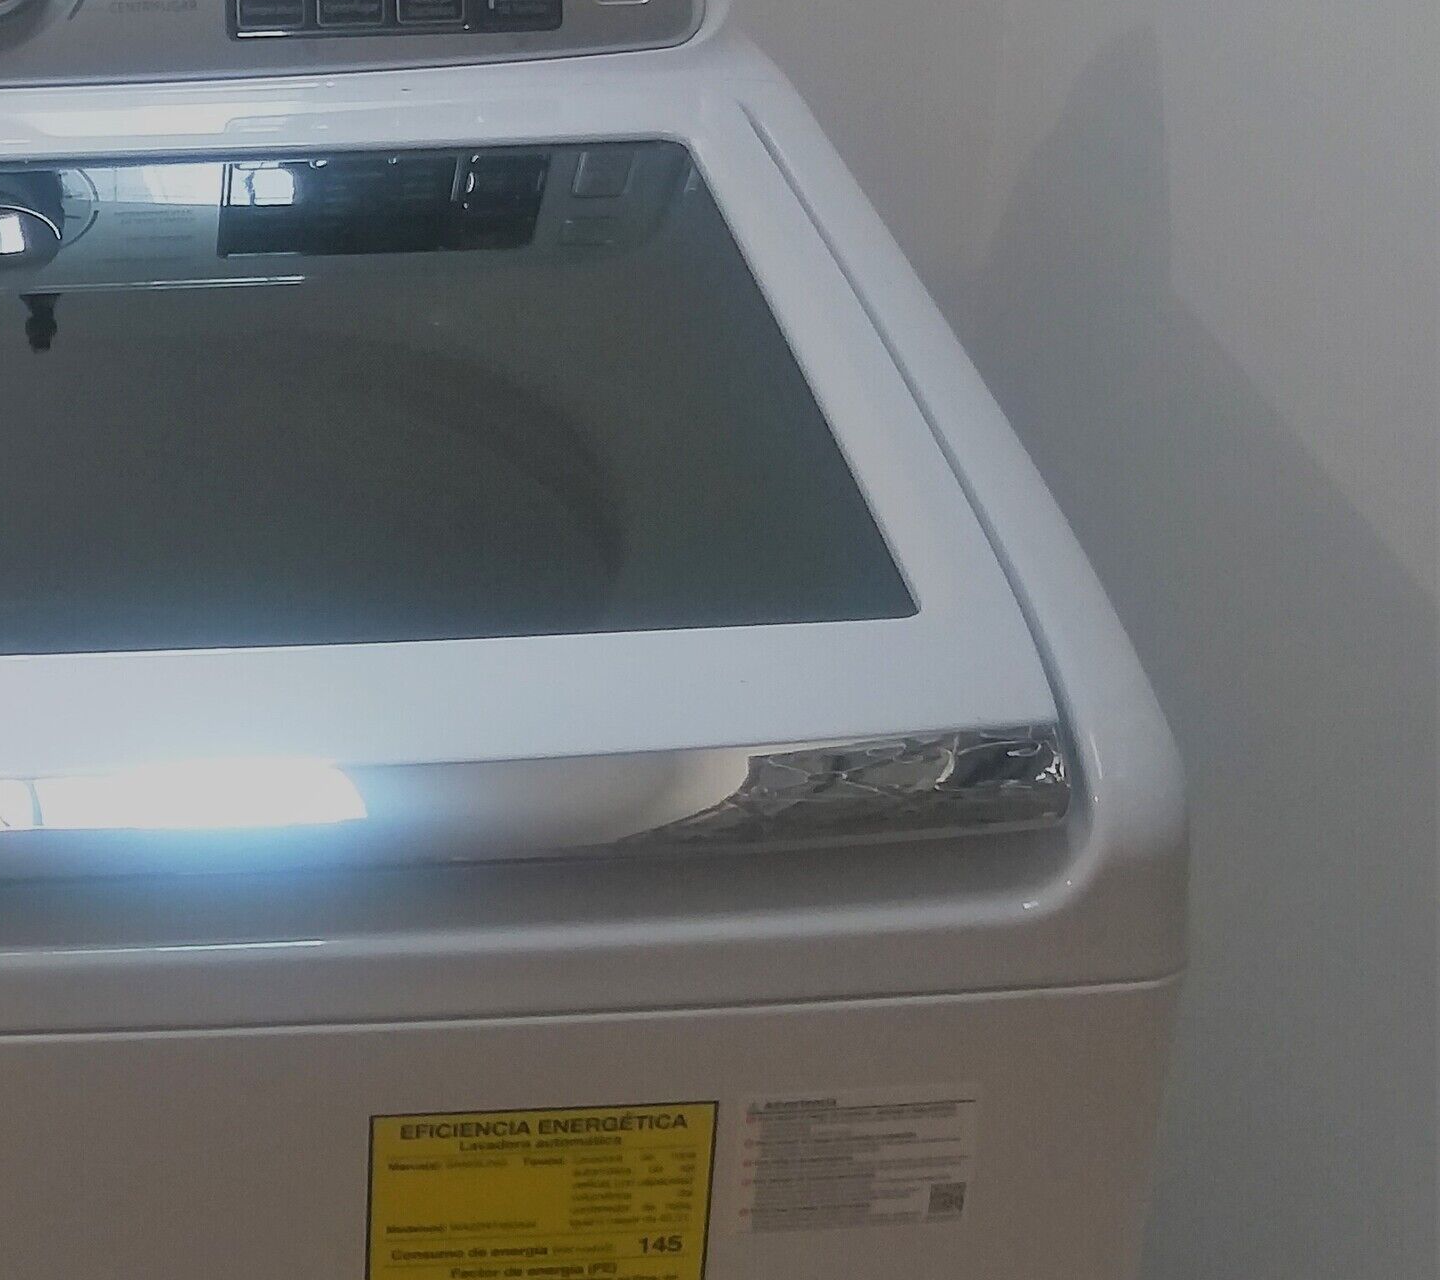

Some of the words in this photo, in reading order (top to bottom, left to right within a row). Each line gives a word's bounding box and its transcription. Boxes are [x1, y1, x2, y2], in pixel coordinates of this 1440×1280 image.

[400, 1120, 531, 1141] EFICIENCIA
[538, 1112, 689, 1135] ENERGÉTICA
[638, 1235, 683, 1254] 145
